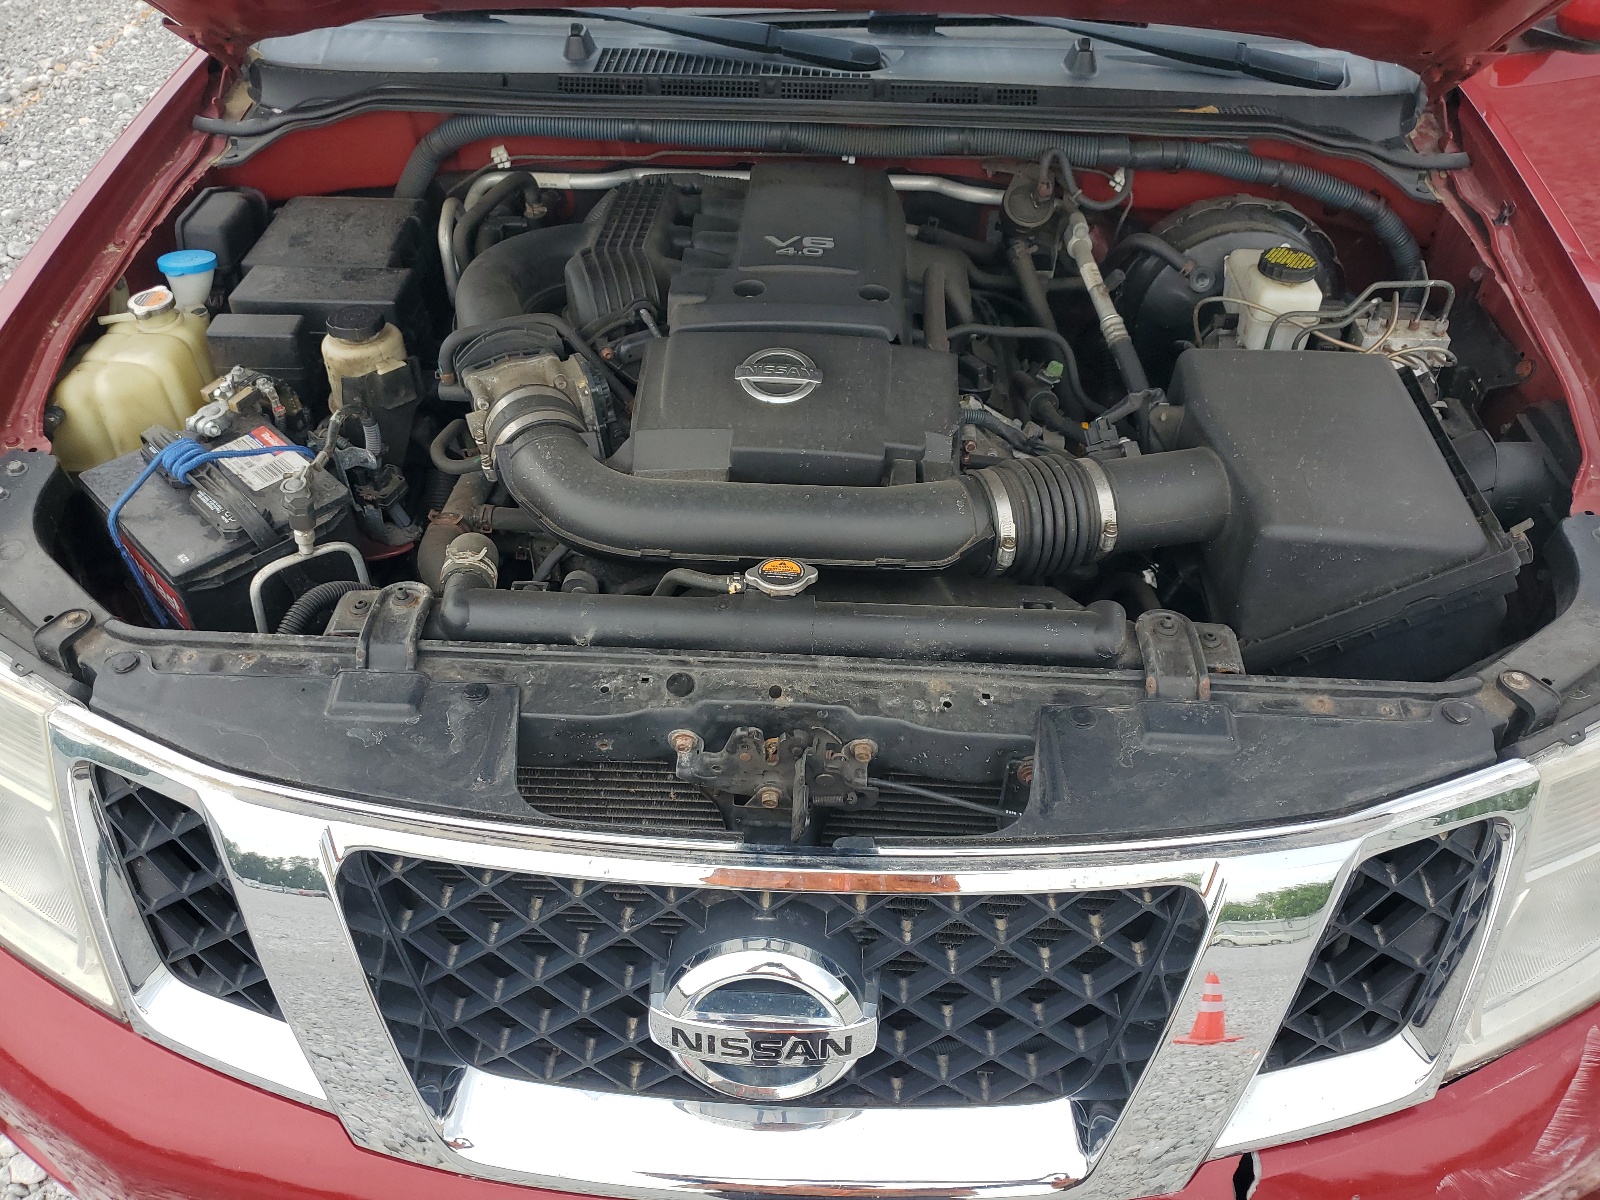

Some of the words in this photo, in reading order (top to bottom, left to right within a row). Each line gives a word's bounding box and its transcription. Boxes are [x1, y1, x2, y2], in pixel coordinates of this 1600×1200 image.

[765, 235, 835, 249] V6
[775, 247, 824, 257] 4.0
[741, 365, 814, 378] NISSAN
[671, 1026, 852, 1061] NISSAN
